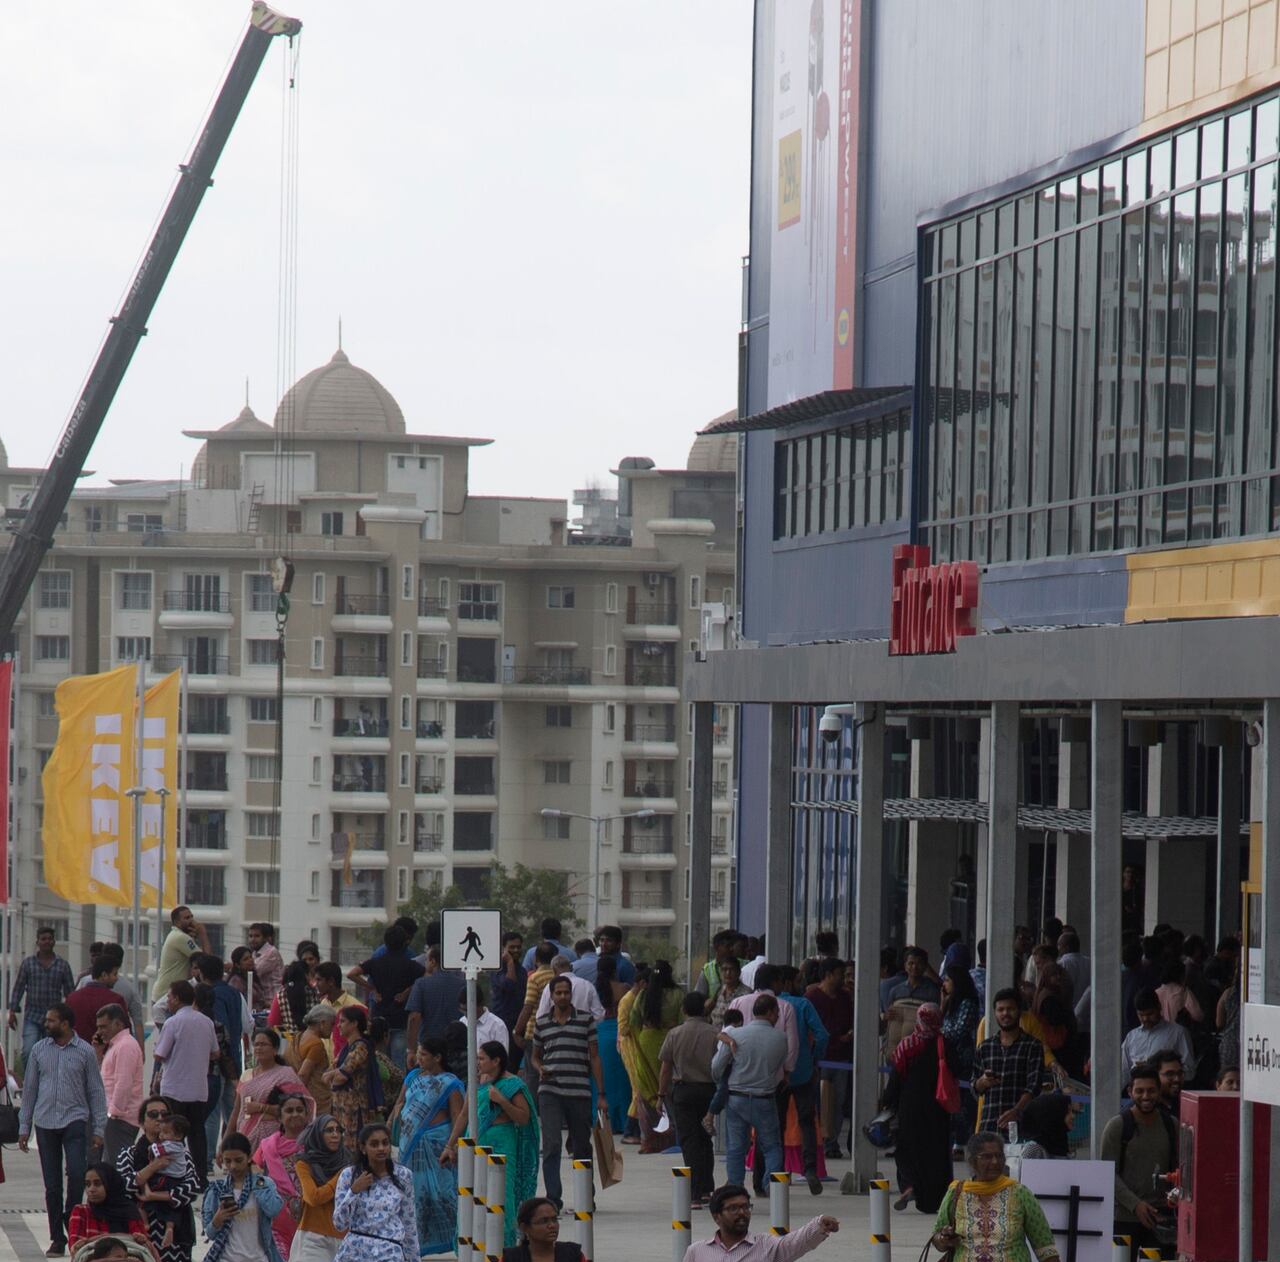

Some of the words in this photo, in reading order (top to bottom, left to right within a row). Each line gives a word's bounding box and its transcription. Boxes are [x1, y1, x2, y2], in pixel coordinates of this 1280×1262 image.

[56, 399, 87, 458] Cabeza
[889, 544, 977, 656] Entrance
[91, 713, 122, 890] IKEA
